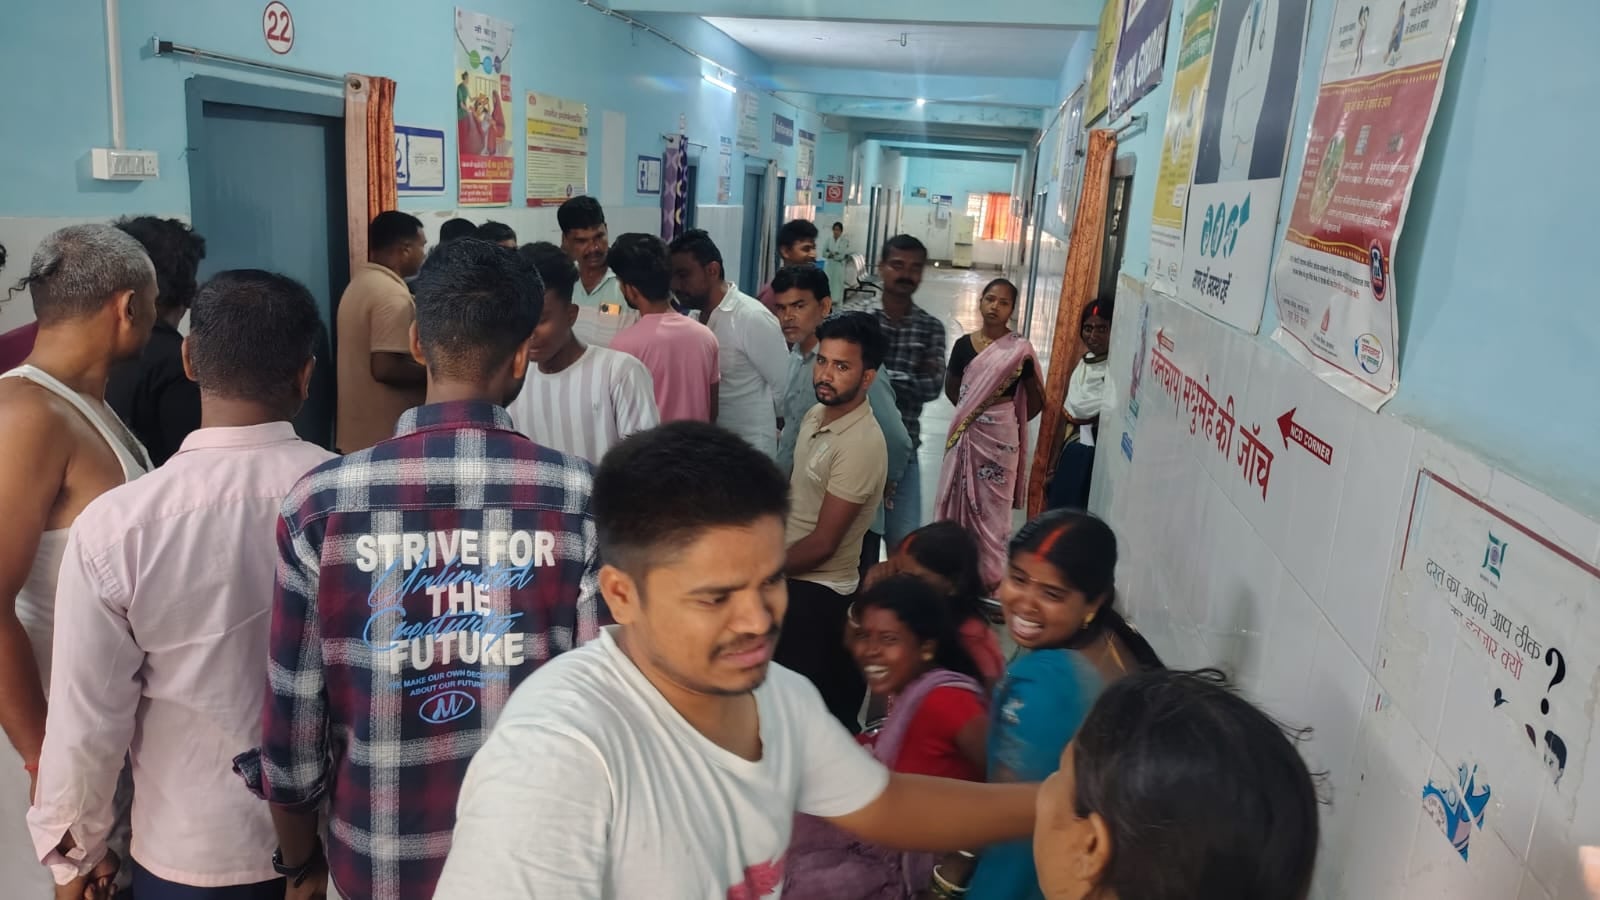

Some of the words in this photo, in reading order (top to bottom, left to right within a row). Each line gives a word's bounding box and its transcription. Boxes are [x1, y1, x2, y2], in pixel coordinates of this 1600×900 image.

[267, 10, 291, 43] 22
[1216, 395, 1235, 462] की
[1290, 423, 1304, 442] NCD
[1303, 433, 1331, 462] CORNER
[356, 530, 480, 572] STRIVE
[488, 530, 556, 568] FOR
[425, 580, 491, 618] THE
[1446, 574, 1461, 598] का
[1462, 587, 1489, 620] अपने
[1490, 609, 1512, 640] आप
[1514, 624, 1543, 660] ठीक
[388, 631, 525, 675] FUTURE
[1501, 648, 1524, 681] क्यों
[403, 677, 426, 688] MAKE
[427, 672, 445, 682] OUR
[446, 668, 465, 678] OWN
[409, 684, 438, 697] ABOUT
[438, 681, 456, 690] OUR
[457, 679, 486, 689] FUTURE
